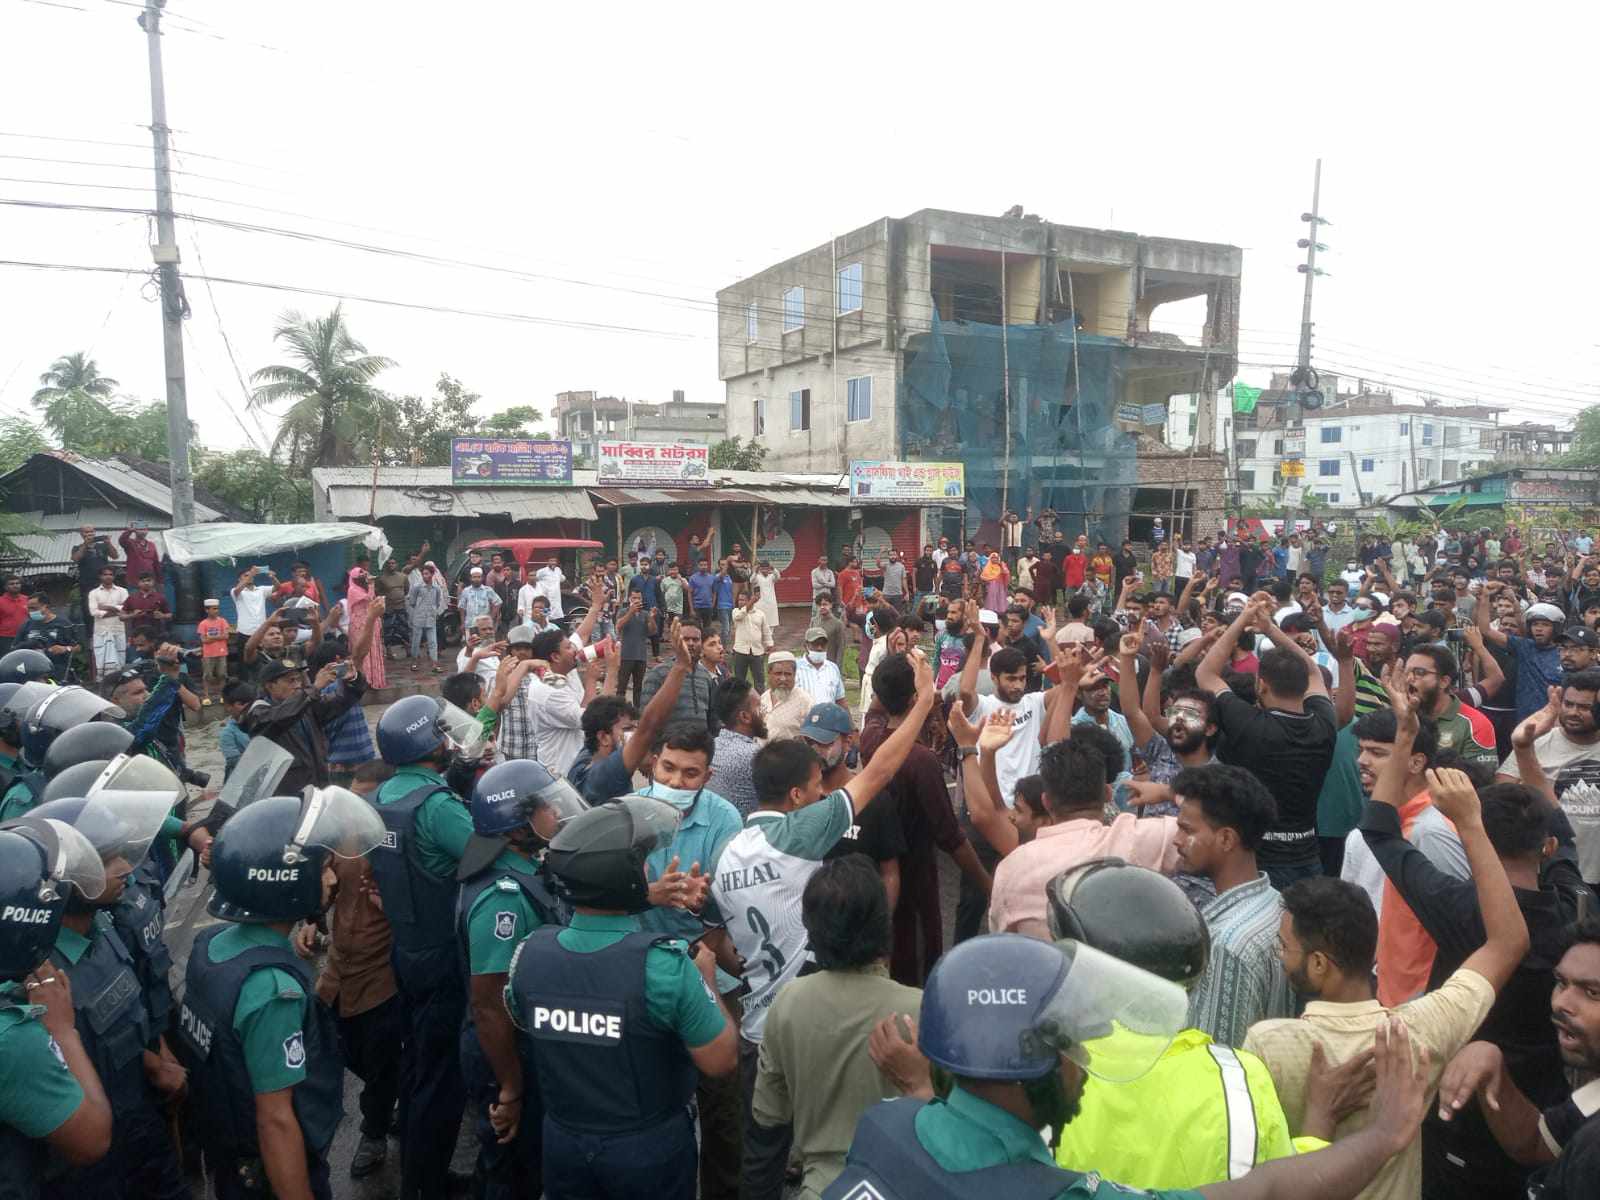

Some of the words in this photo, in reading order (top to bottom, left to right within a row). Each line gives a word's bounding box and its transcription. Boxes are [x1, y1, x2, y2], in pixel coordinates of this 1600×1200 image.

[601, 443, 655, 459] সাব্বির
[660, 445, 708, 460] মটরস
[405, 715, 429, 734] POLICE
[486, 789, 516, 804] POLICE
[248, 869, 299, 881] POLICE
[720, 862, 780, 892] HELAL
[2, 906, 52, 923] POLICE
[747, 906, 786, 982] 3
[967, 988, 1027, 1005] POLICE
[181, 1004, 212, 1055] POLICE
[533, 1006, 622, 1039] POLICE
